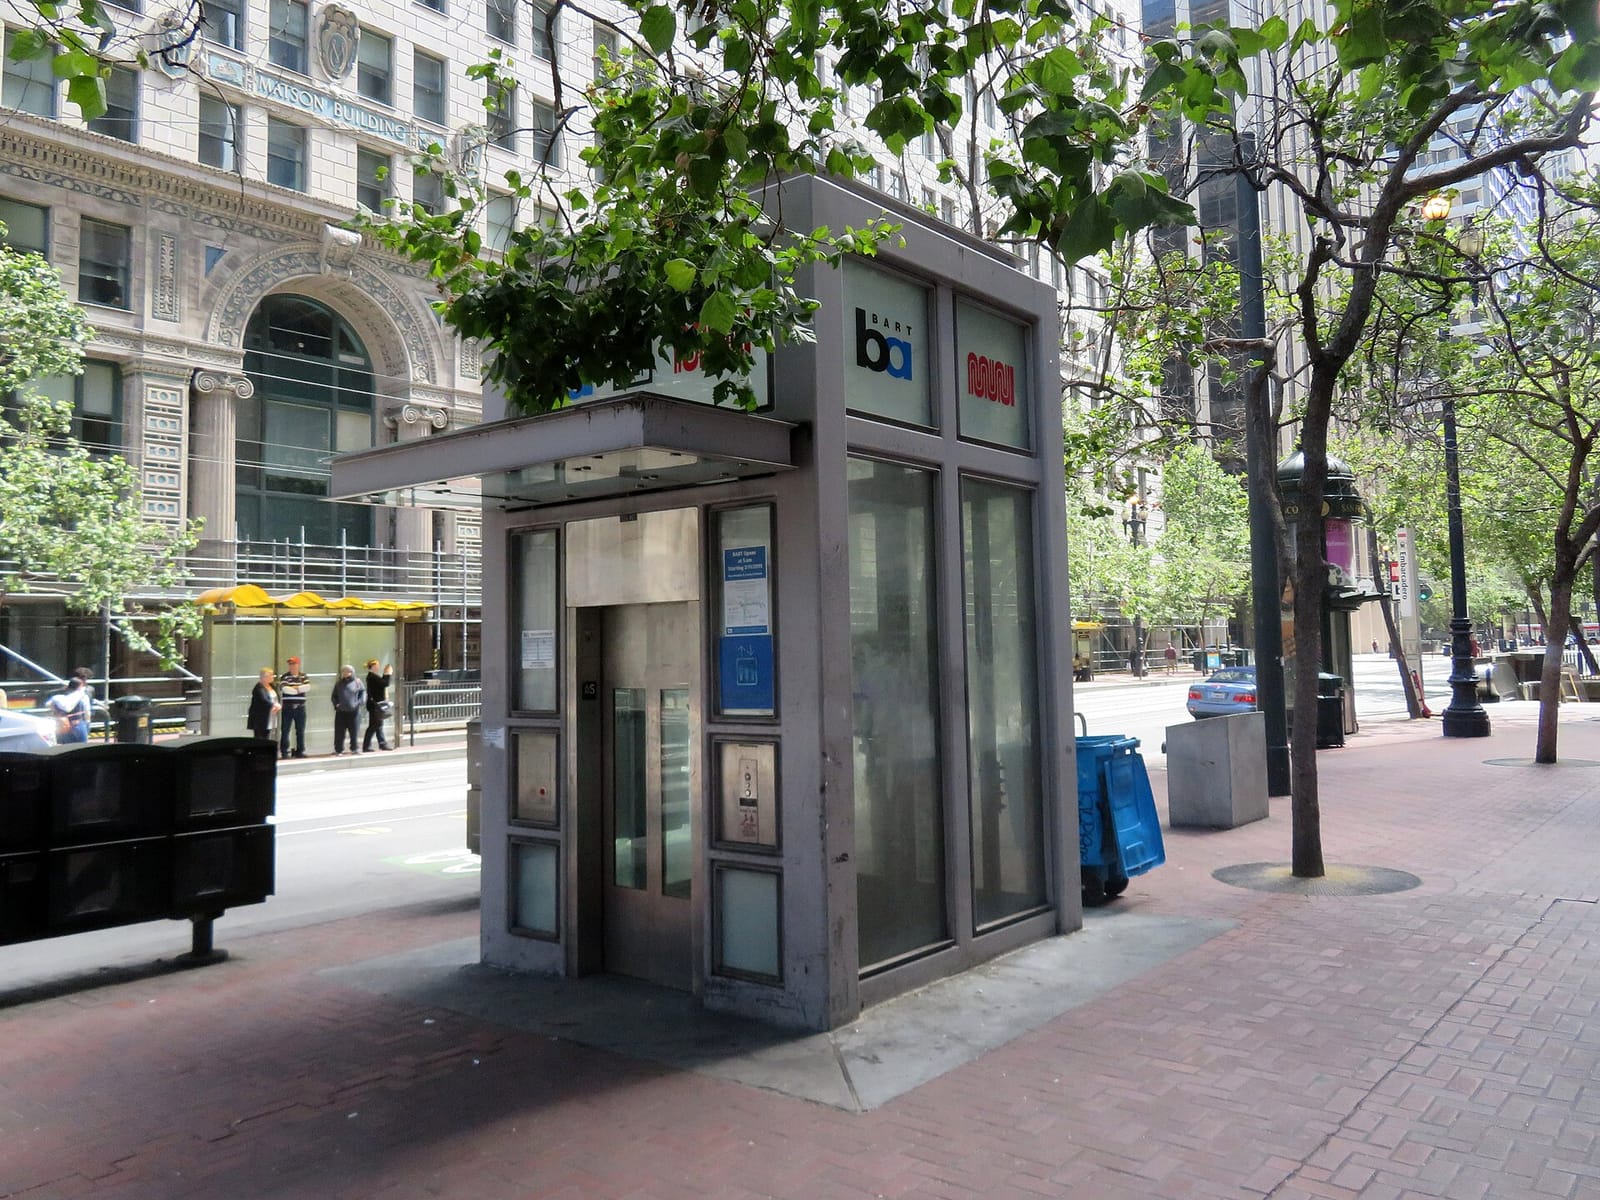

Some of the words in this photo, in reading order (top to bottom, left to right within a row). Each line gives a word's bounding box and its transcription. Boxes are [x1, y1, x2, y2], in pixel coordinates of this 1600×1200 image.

[258, 75, 325, 113] MATSON
[333, 103, 406, 141] BUILDING
[872, 313, 912, 336] BART
[1399, 551, 1408, 600] Embarcadero
